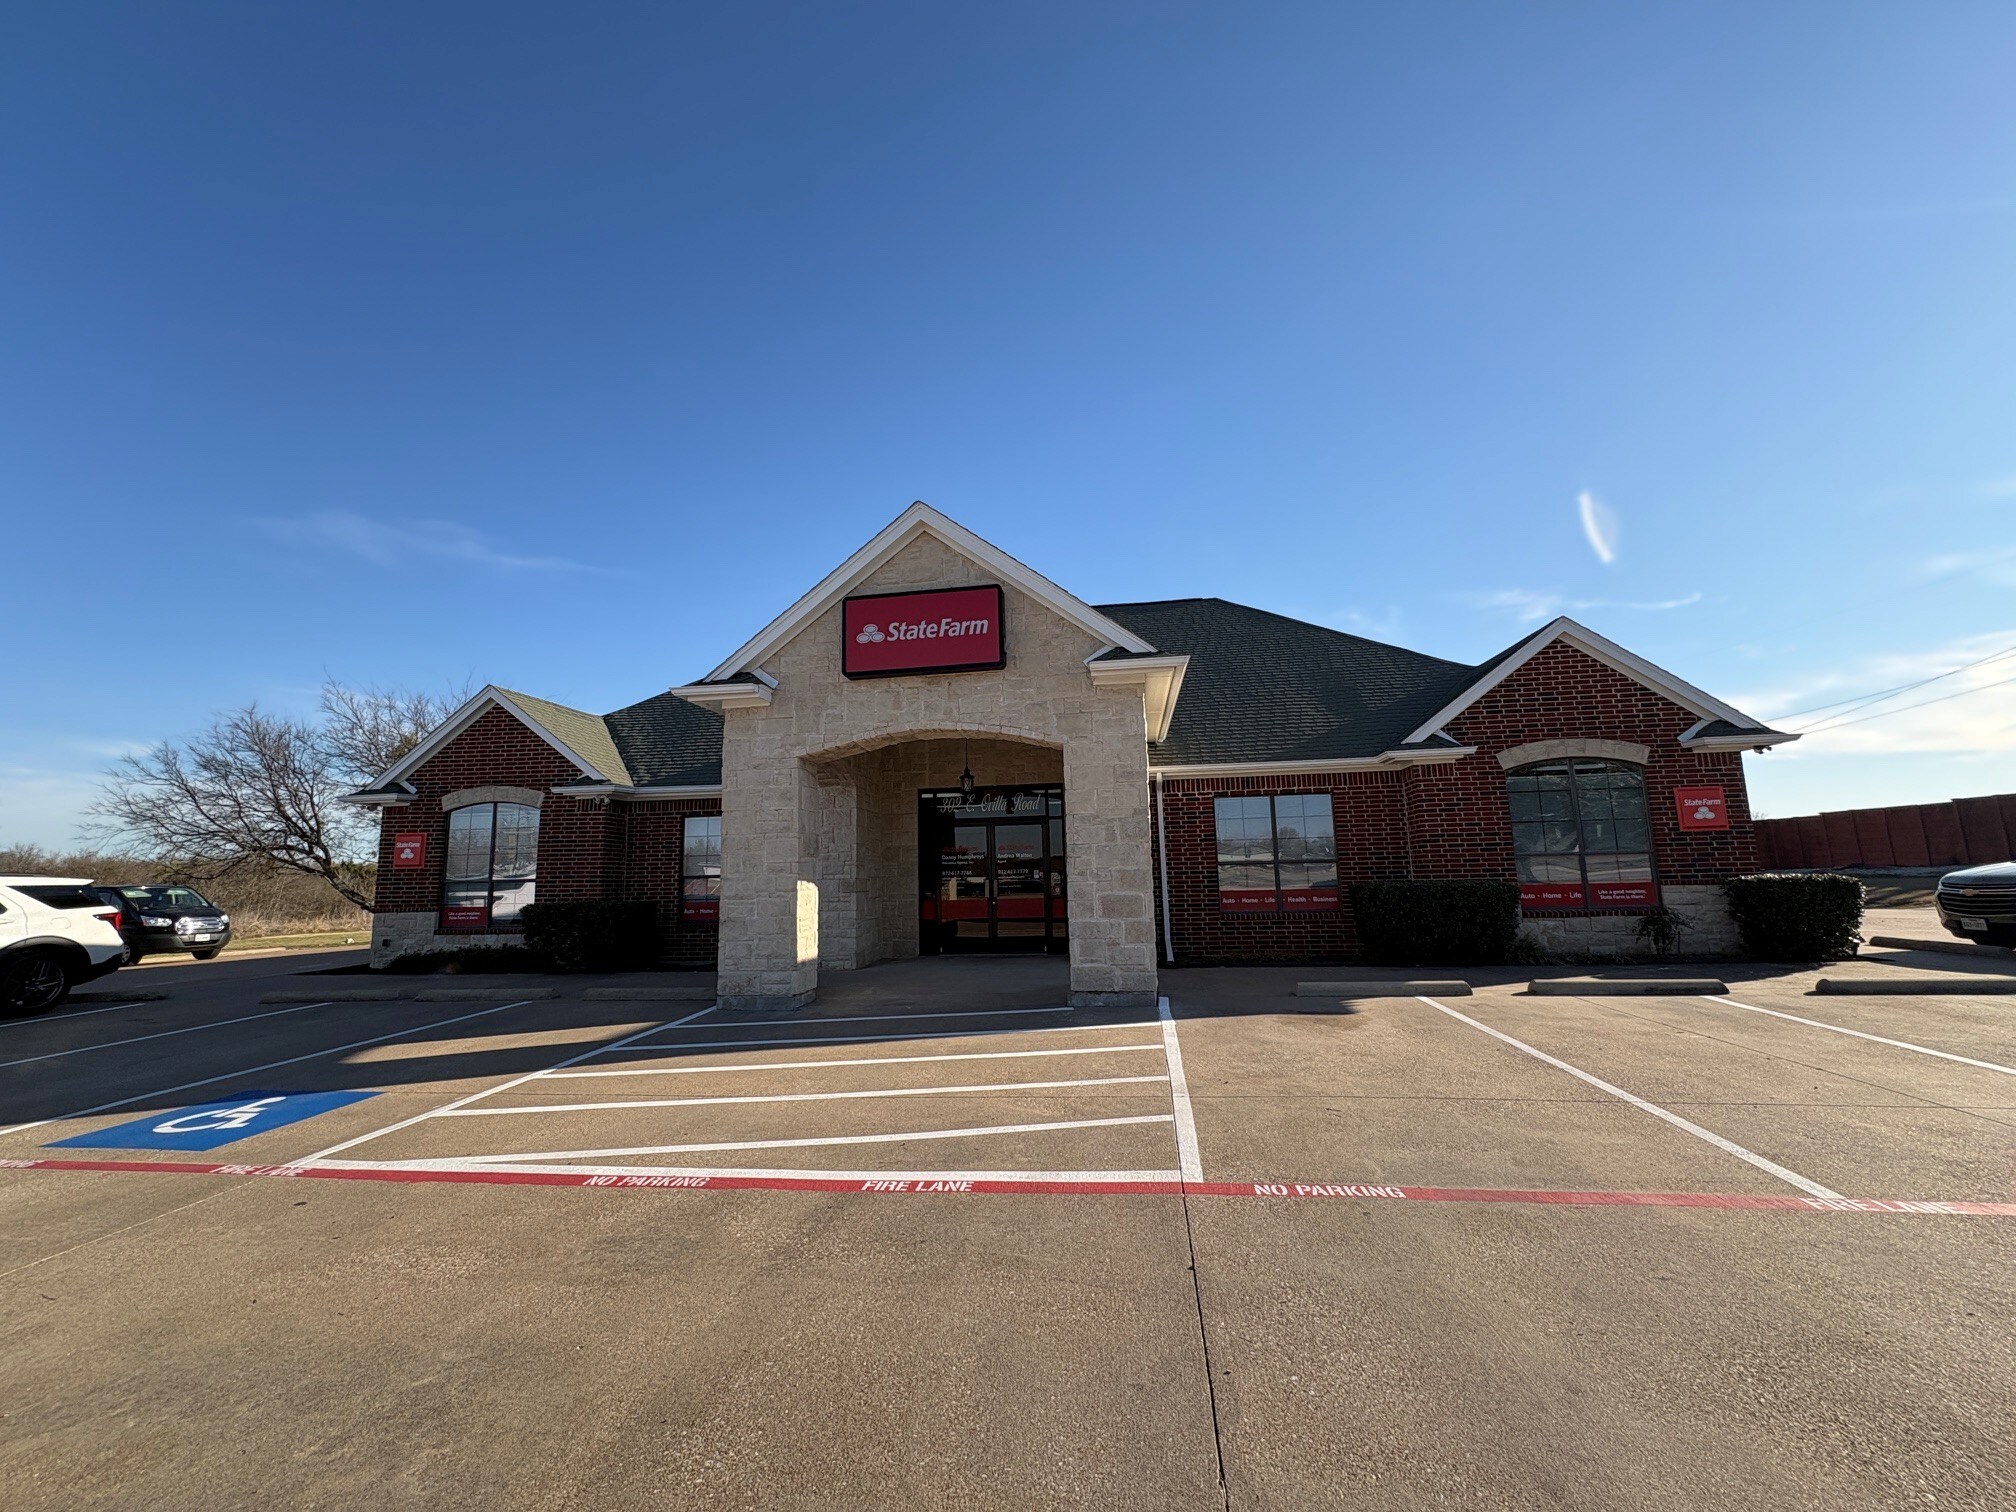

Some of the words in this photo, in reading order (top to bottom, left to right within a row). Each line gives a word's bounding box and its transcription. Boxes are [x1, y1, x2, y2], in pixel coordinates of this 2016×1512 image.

[940, 797, 962, 813] 302
[1011, 792, 1041, 811] Road
[582, 1176, 618, 1186] NO
[616, 1176, 710, 1187] PARKING
[861, 1180, 911, 1191] FIRE
[914, 1181, 974, 1192] LANE
[1254, 1184, 1288, 1195] NO
[1294, 1184, 1407, 1198] PARKING
